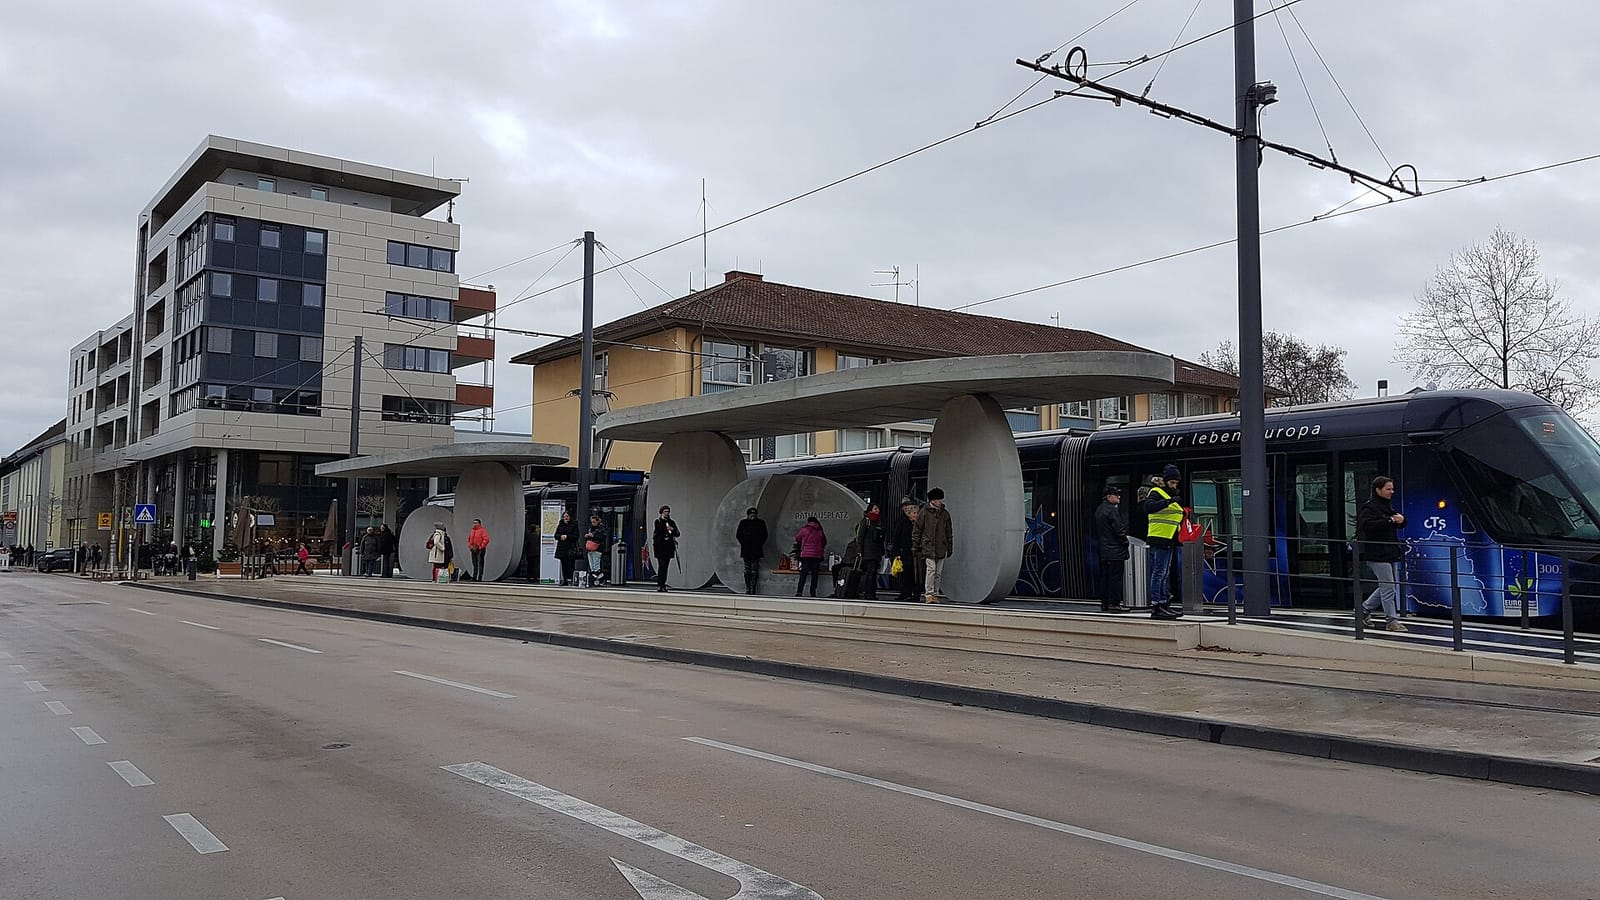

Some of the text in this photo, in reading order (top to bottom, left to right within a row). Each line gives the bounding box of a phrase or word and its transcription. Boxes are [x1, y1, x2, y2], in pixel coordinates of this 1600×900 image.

[1156, 424, 1322, 448] Wir leben uropa
